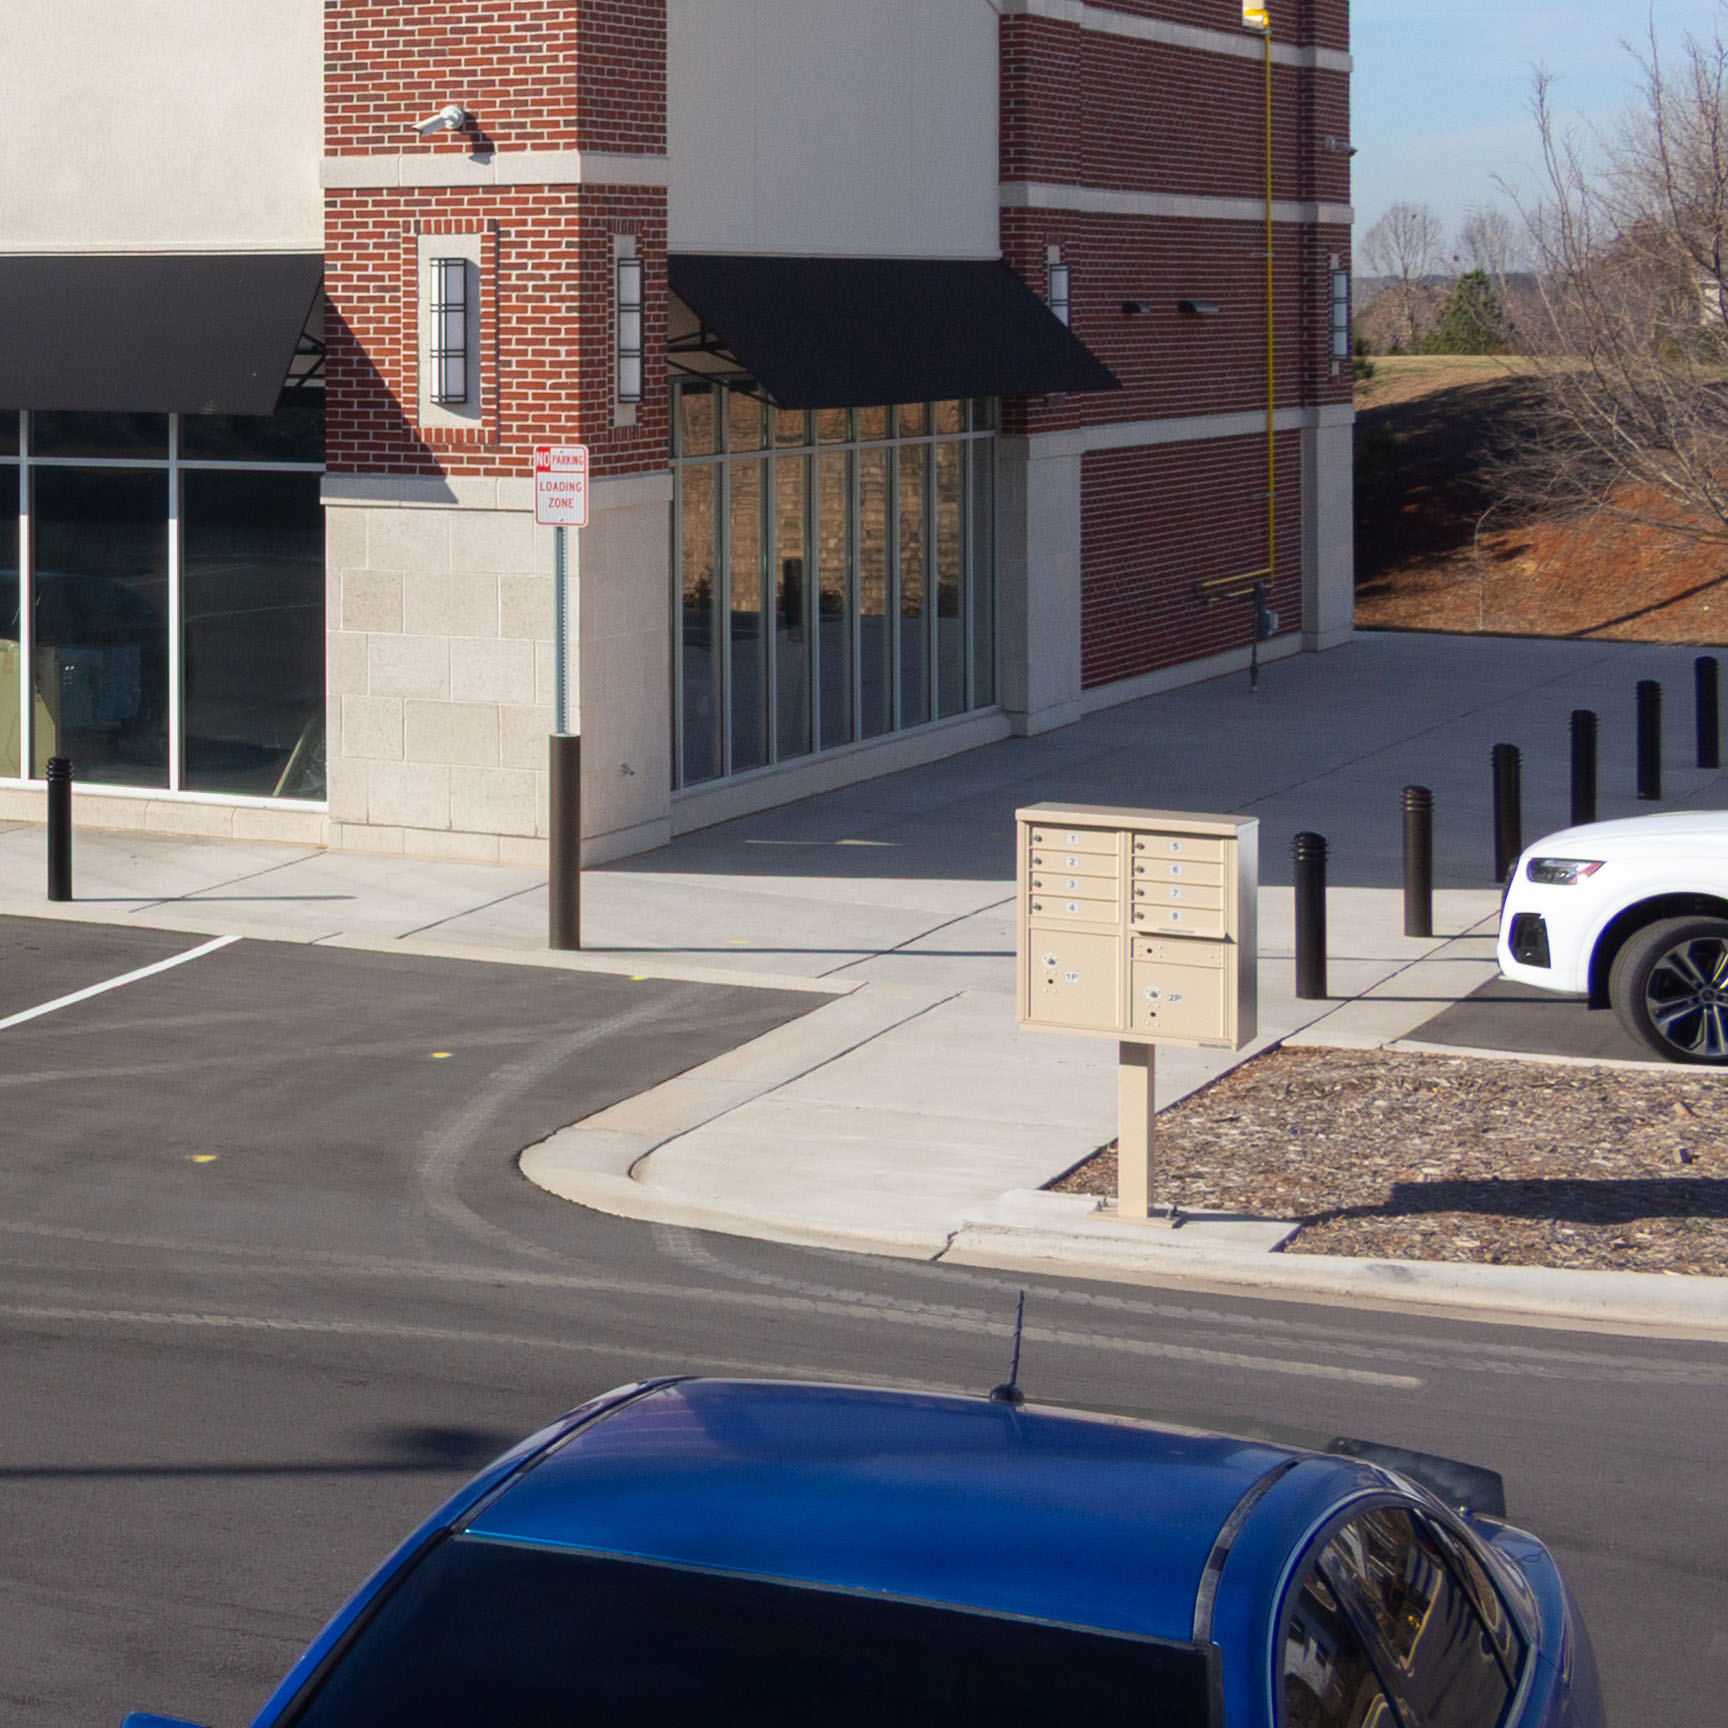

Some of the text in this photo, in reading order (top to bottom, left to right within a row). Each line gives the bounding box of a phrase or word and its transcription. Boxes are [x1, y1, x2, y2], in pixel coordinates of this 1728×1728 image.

[536, 451, 584, 467] NO PARKING
[539, 481, 582, 493] LOADING
[548, 497, 574, 508] ZONE
[1066, 972, 1078, 981] 1P
[1168, 994, 1181, 1002] 2P
